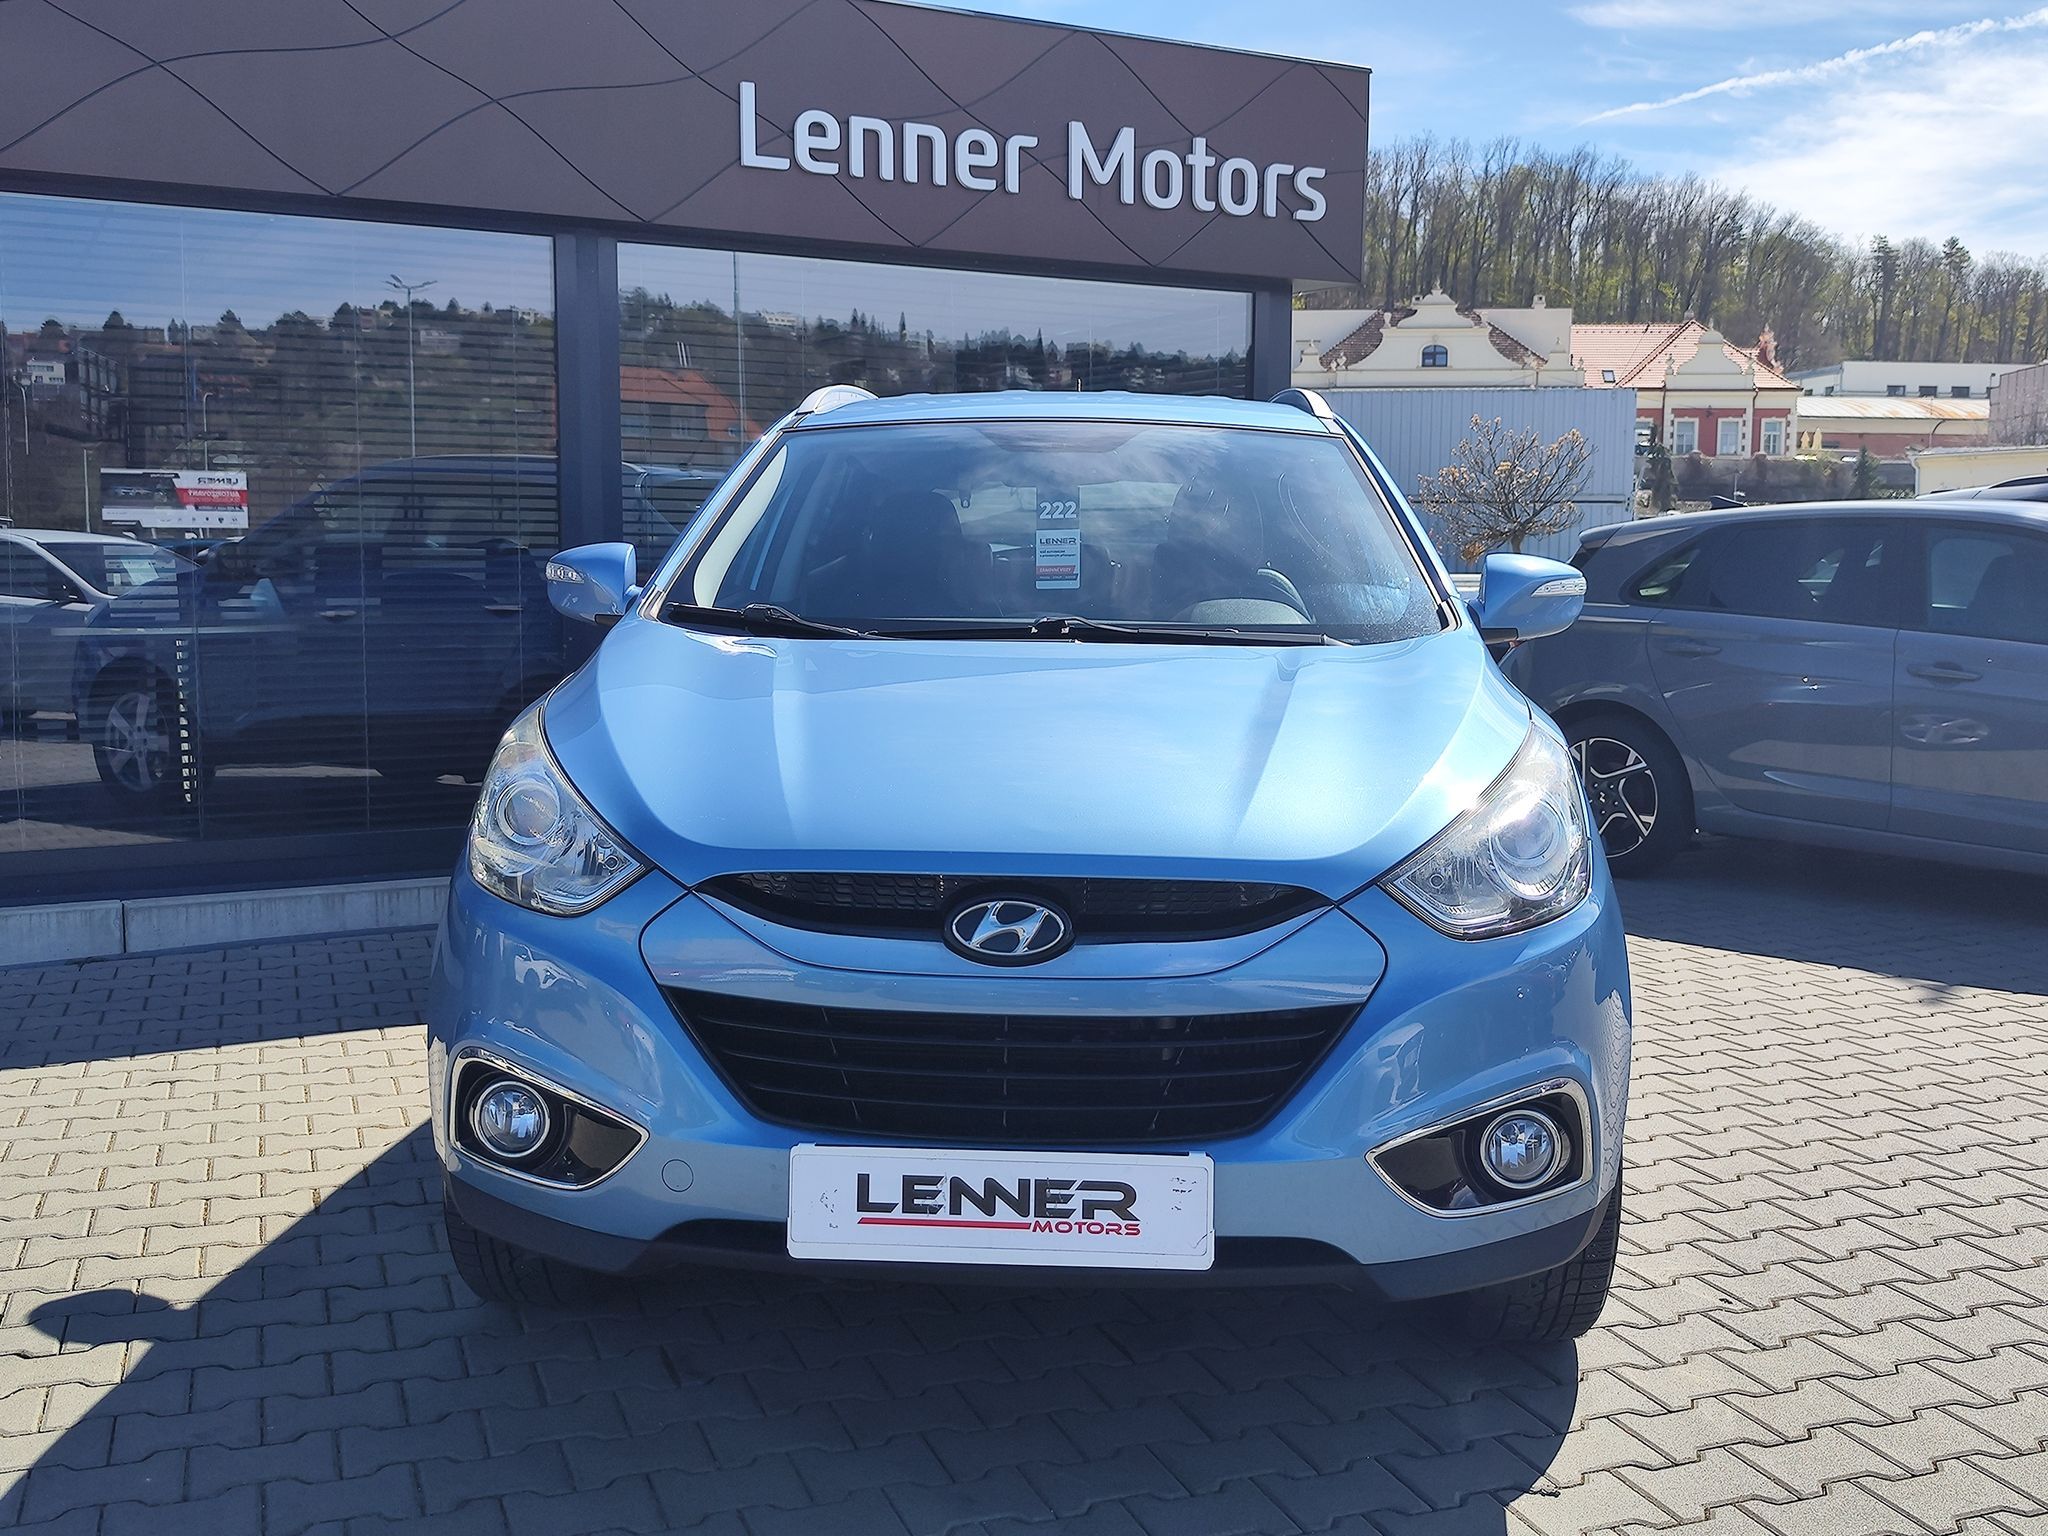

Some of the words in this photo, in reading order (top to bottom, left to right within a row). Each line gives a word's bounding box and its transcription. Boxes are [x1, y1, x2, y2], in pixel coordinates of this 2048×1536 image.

[739, 81, 1039, 194] Lenner
[1068, 120, 1328, 222] Motors
[1040, 501, 1077, 519] 222
[1040, 537, 1077, 545] LENNER
[857, 1173, 1141, 1221] LENNER
[1031, 1220, 1141, 1236] MOTORS
